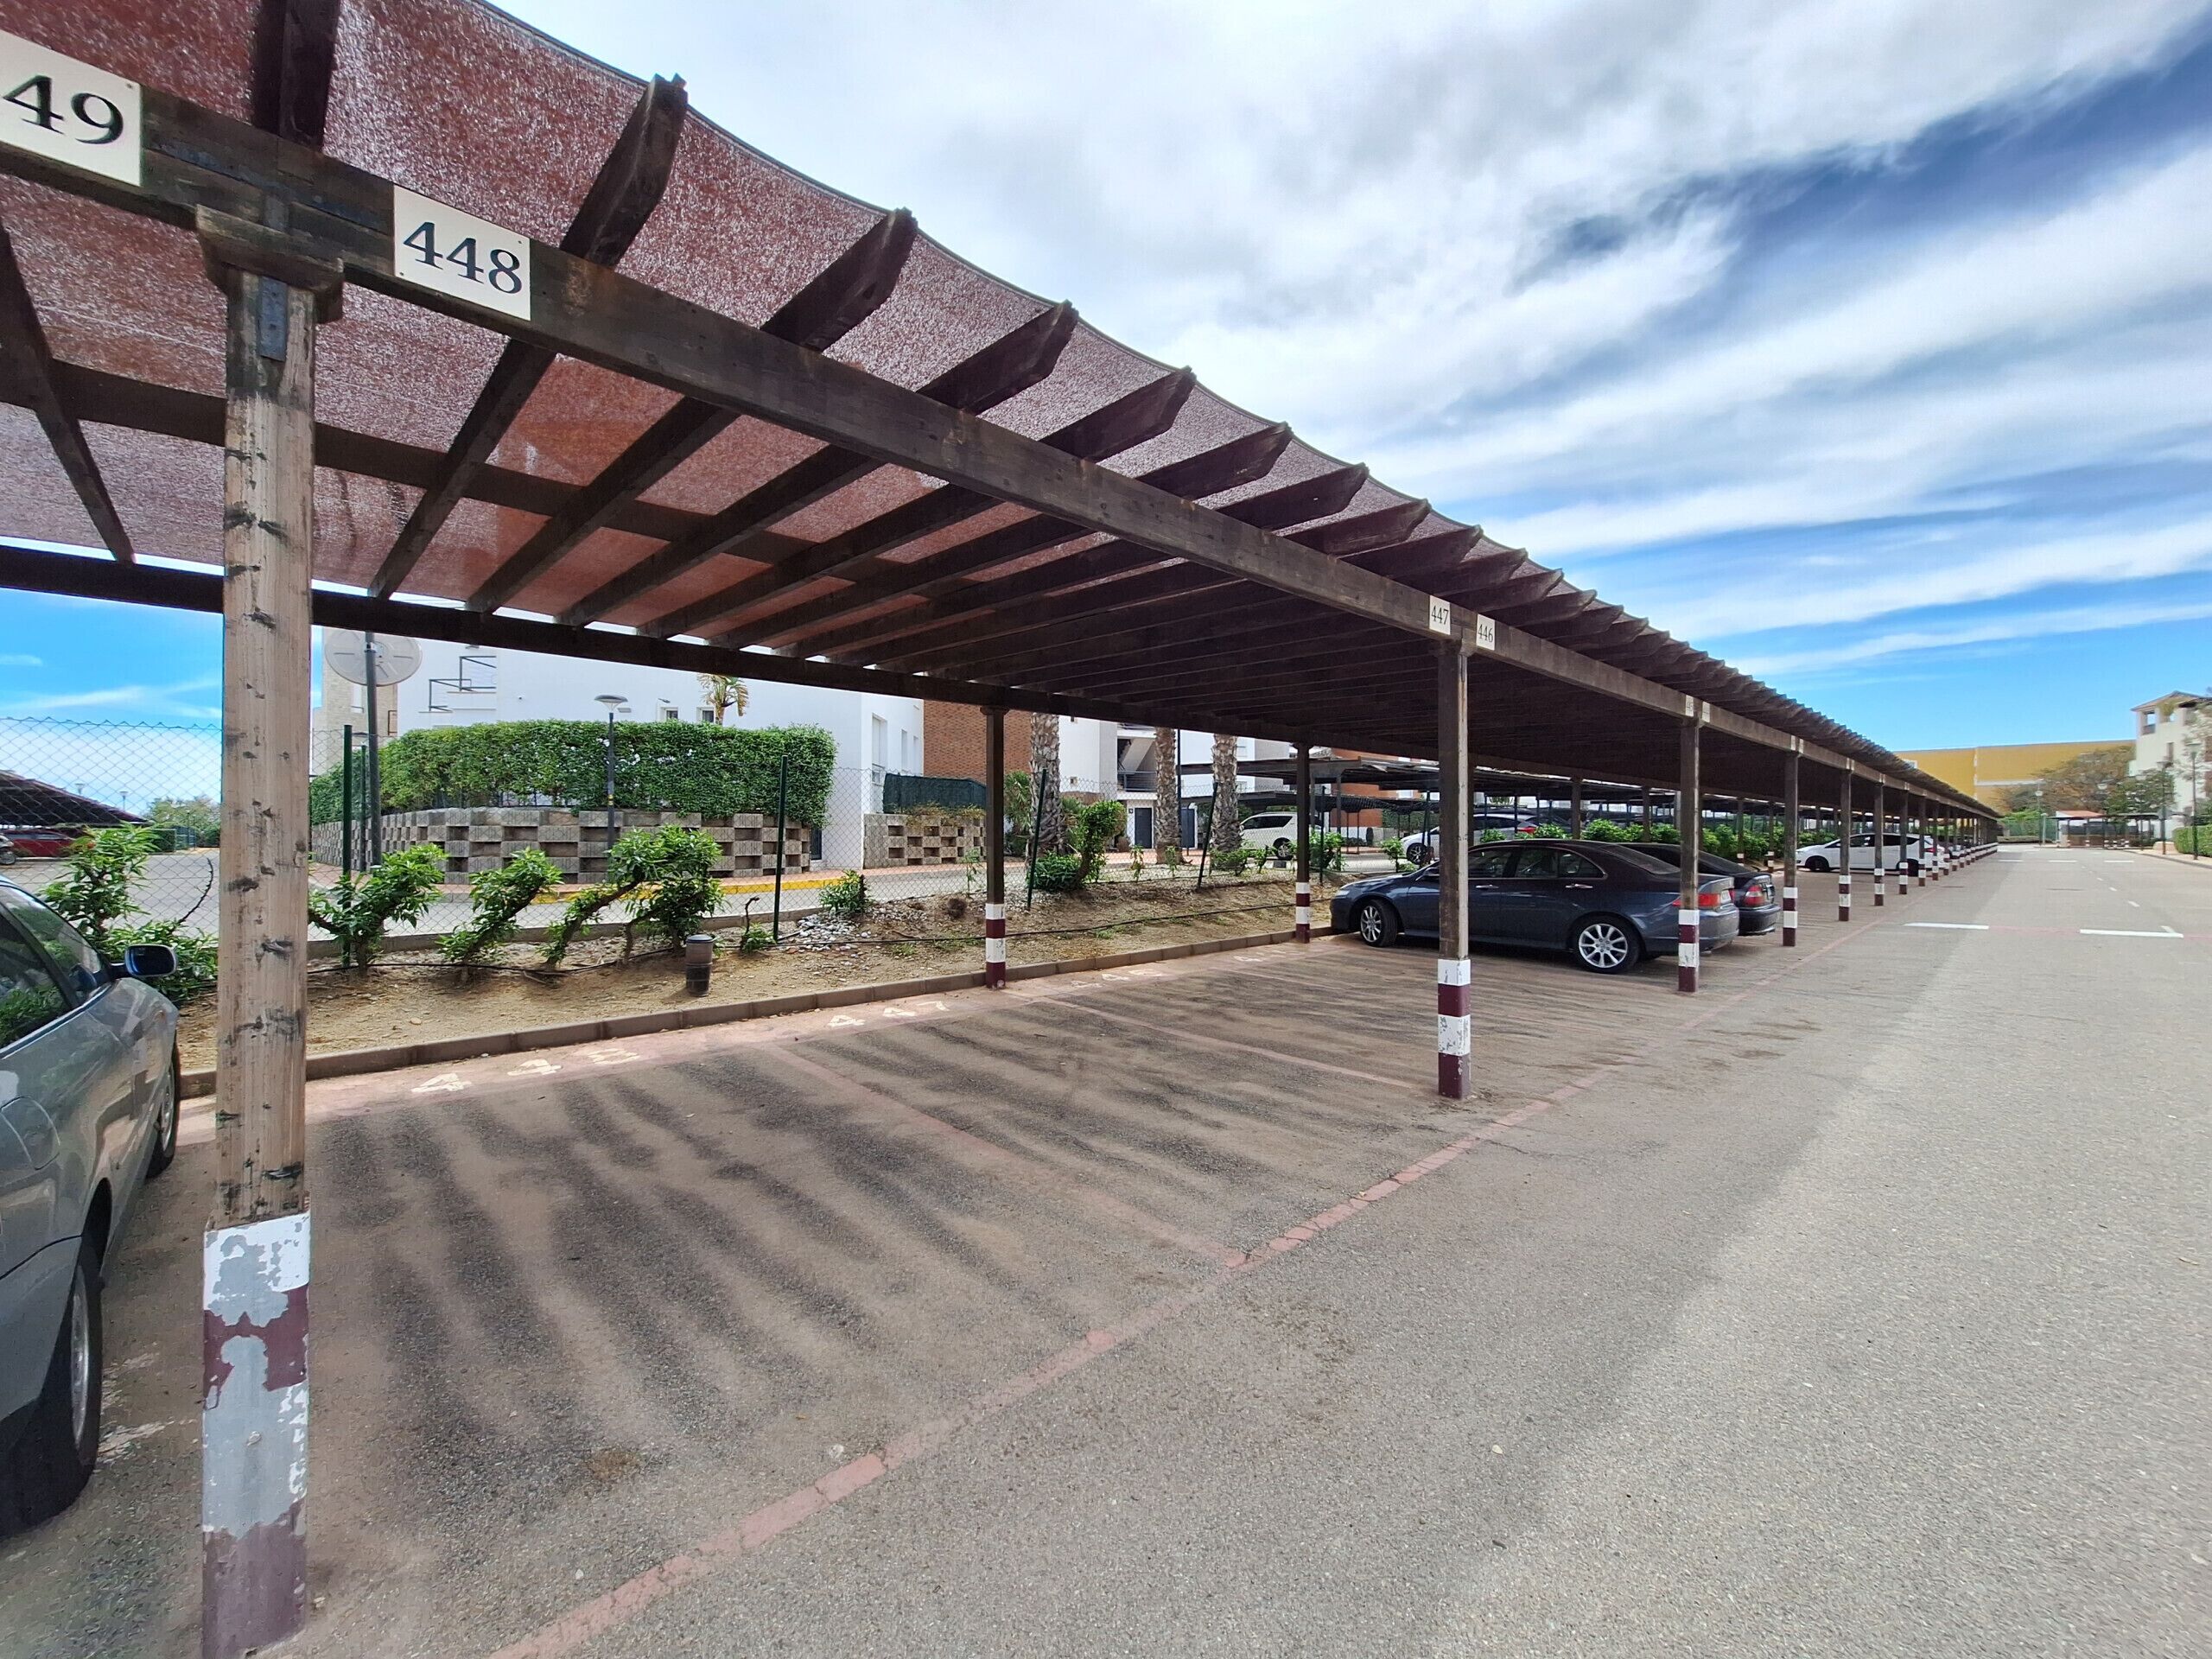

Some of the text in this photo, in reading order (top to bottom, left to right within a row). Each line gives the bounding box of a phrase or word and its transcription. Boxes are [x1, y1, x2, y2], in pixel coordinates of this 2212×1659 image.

[403, 221, 523, 295] 448
[1431, 605, 1450, 626] 447
[1478, 623, 1494, 643] 446
